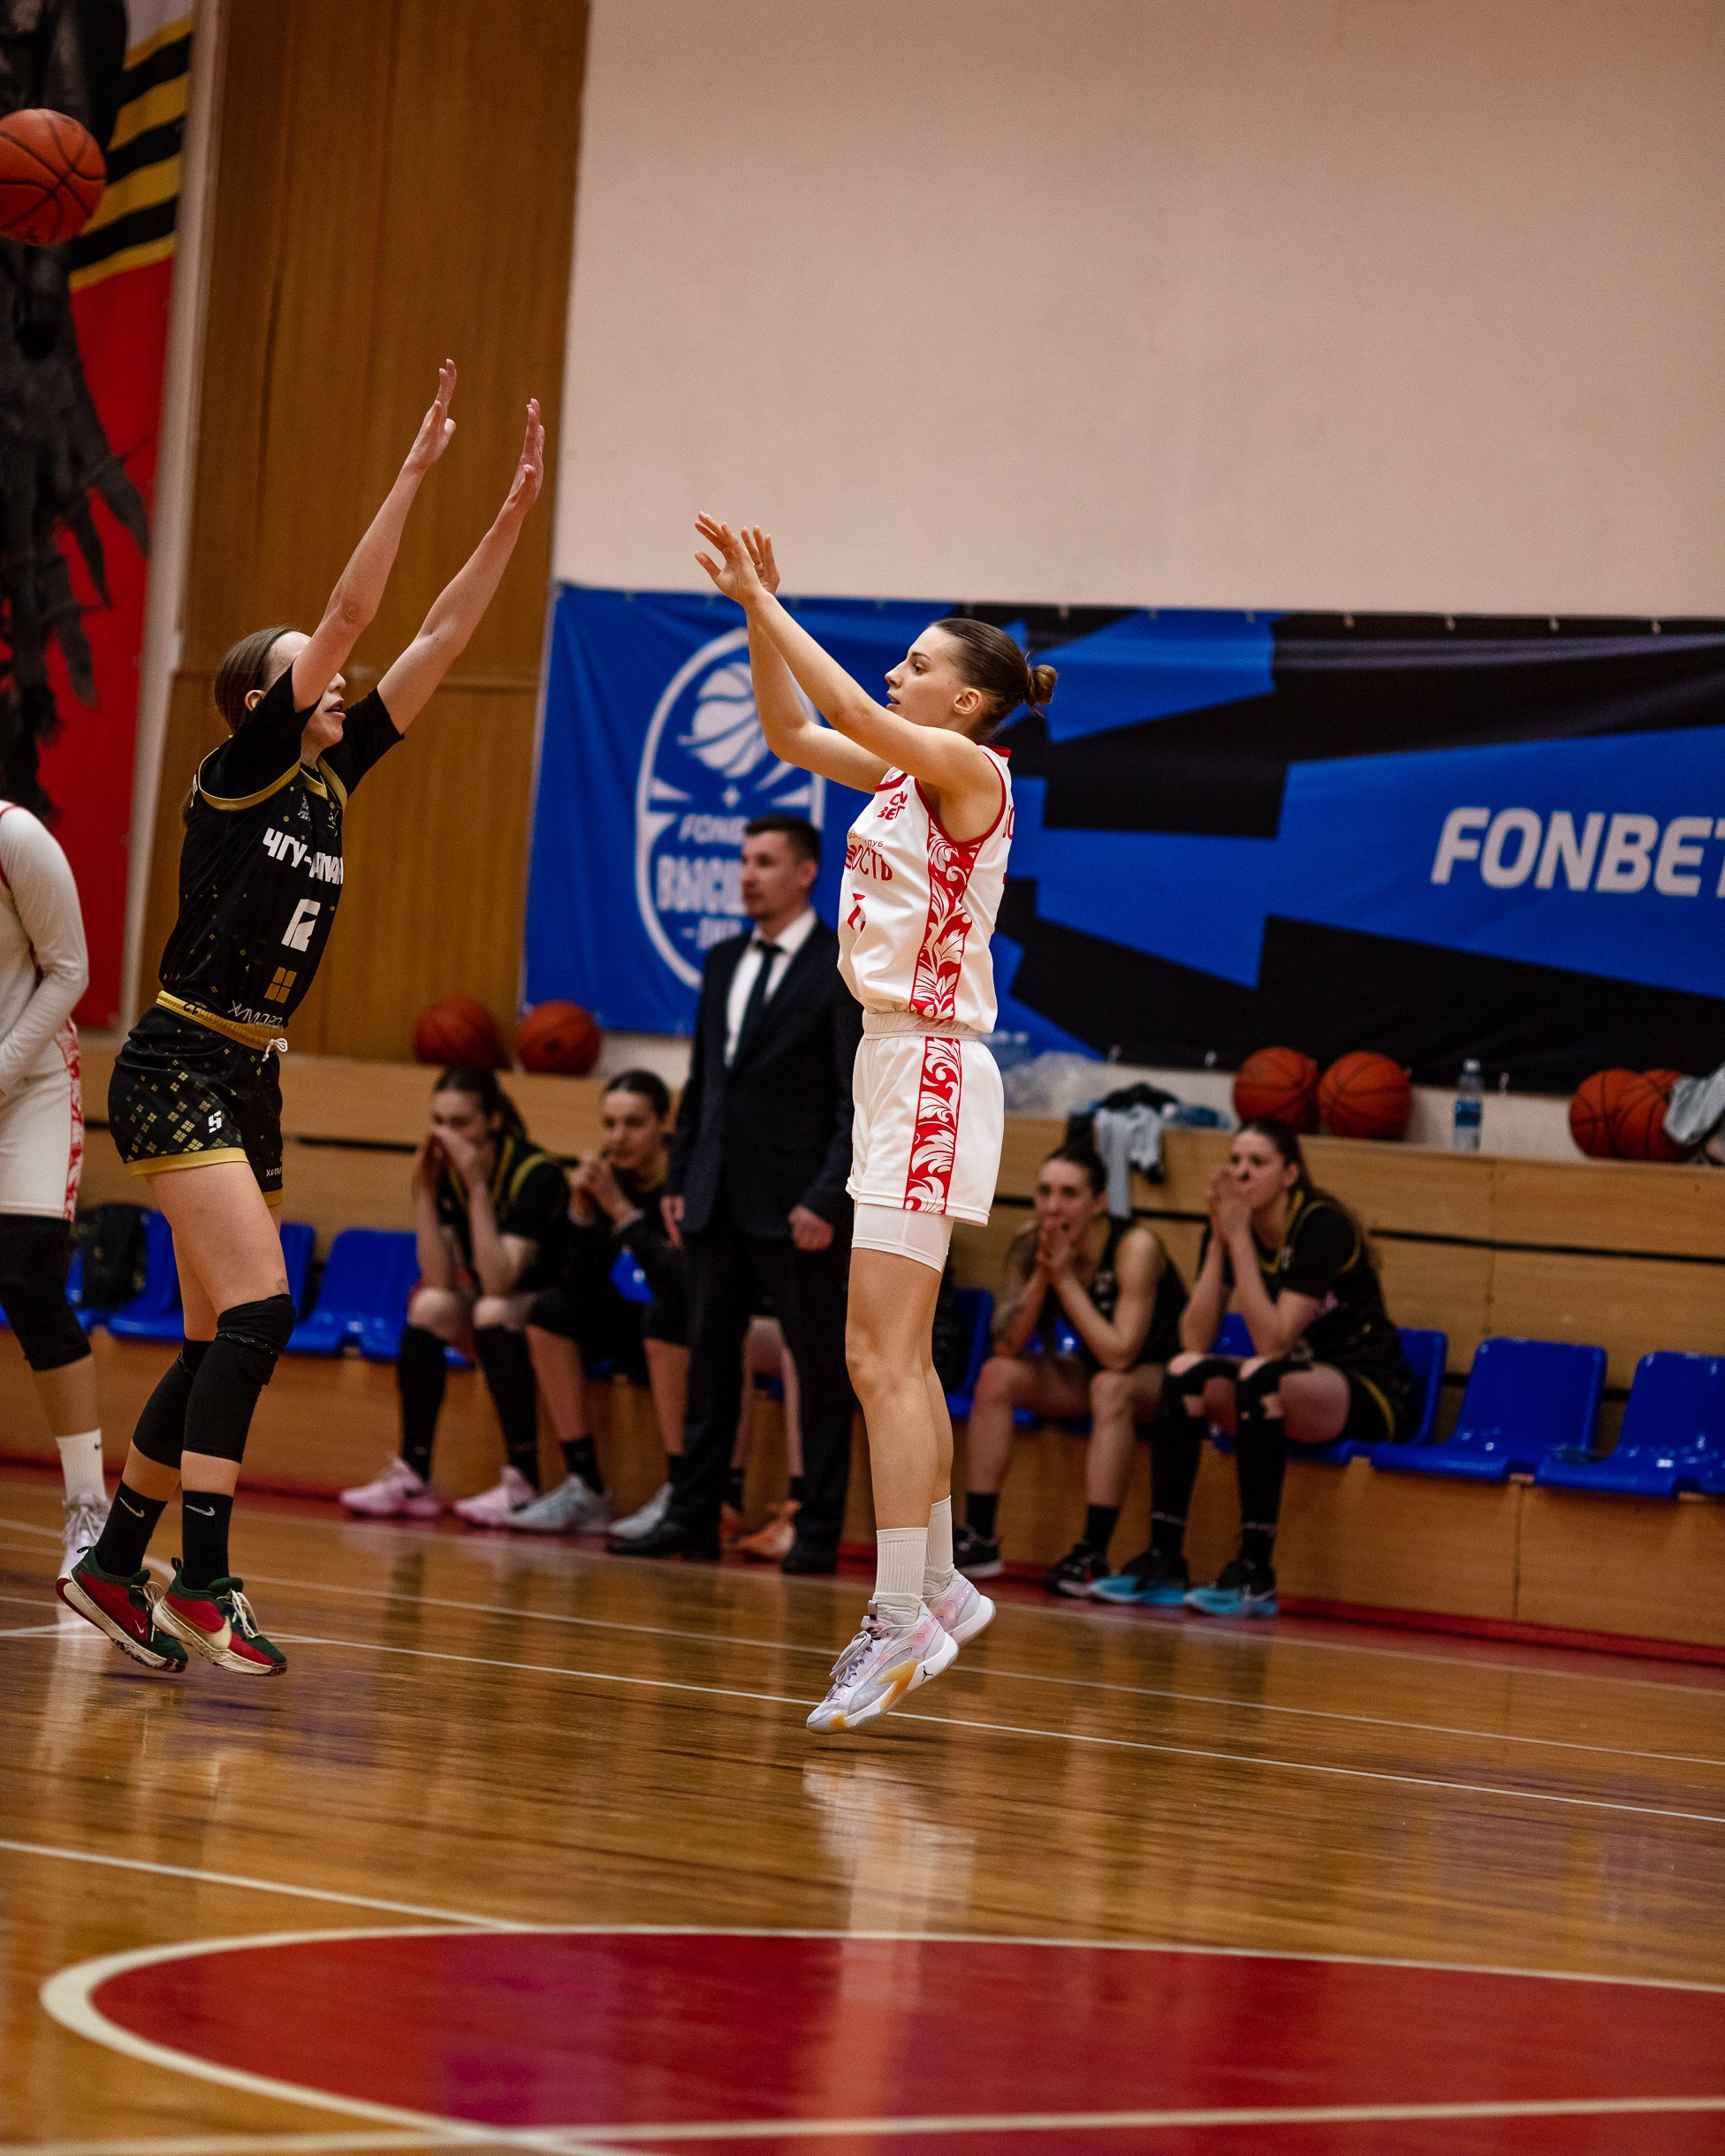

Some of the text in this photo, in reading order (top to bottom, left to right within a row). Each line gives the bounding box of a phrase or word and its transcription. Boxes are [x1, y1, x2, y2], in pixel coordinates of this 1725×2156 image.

[845, 844, 893, 881] ОСТЬ
[1430, 806, 1725, 899] FONBE
[265, 1166, 282, 1178] ХИМ
